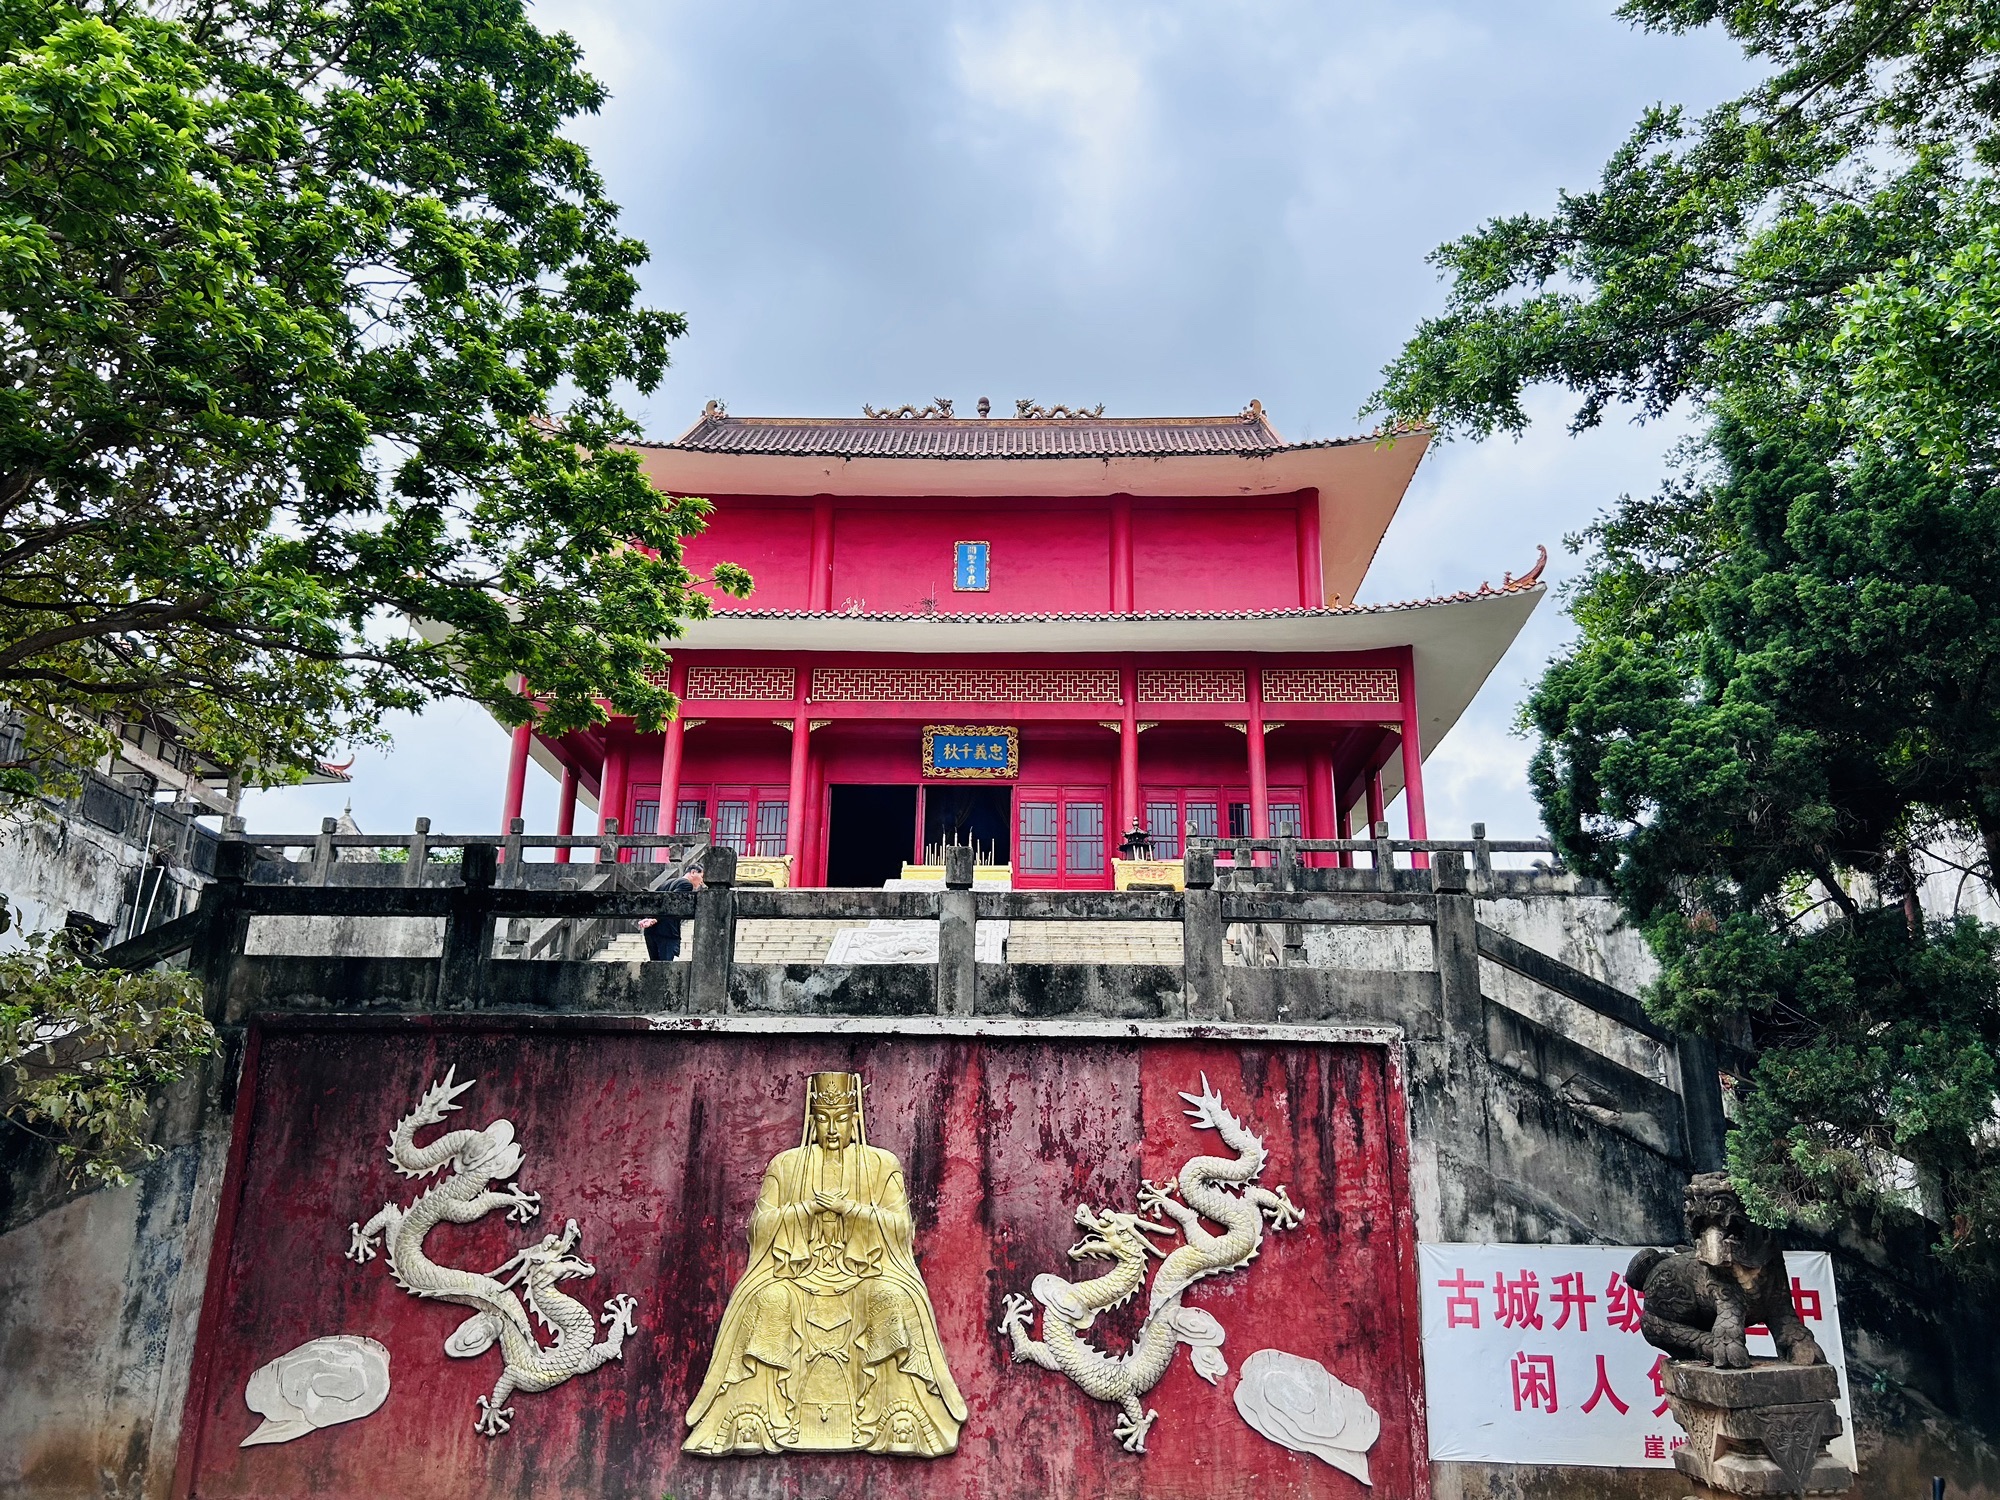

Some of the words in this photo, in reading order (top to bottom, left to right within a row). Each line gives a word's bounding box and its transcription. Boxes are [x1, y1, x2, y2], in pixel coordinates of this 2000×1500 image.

[943, 742, 1003, 761] 忠義千秋
[1438, 1268, 1822, 1336] 古城升级中
